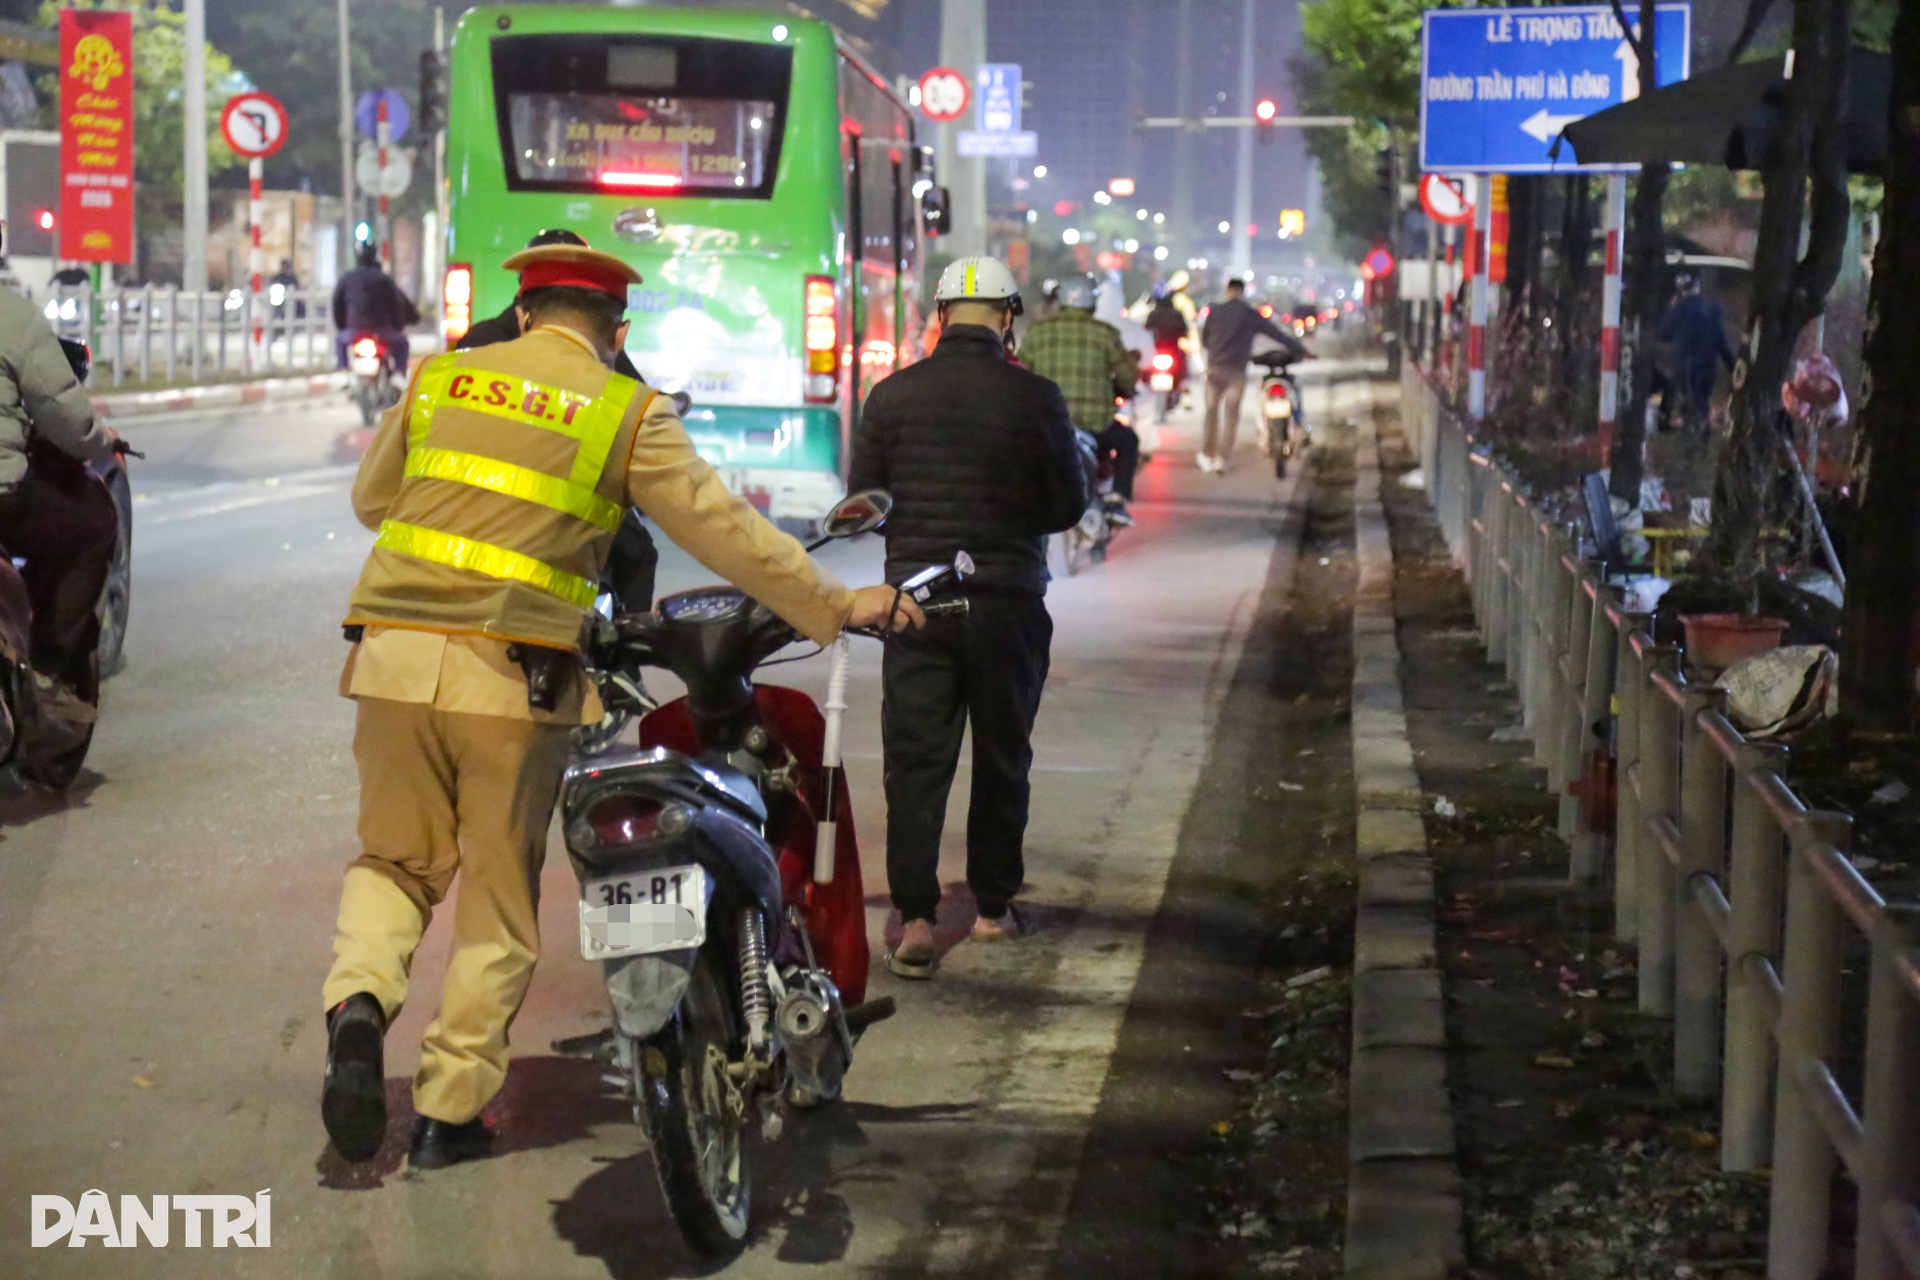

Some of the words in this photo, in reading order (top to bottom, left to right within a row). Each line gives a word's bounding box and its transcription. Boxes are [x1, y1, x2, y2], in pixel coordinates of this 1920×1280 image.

[1486, 15, 1513, 43] LÊ
[1517, 16, 1582, 46] TRỌNG
[1515, 71, 1545, 100] PHÚ
[1547, 70, 1568, 99] HÀ
[1571, 69, 1610, 99] ĐÔNG
[448, 374, 584, 426] C.S.G.T
[599, 874, 682, 906] 36-B1
